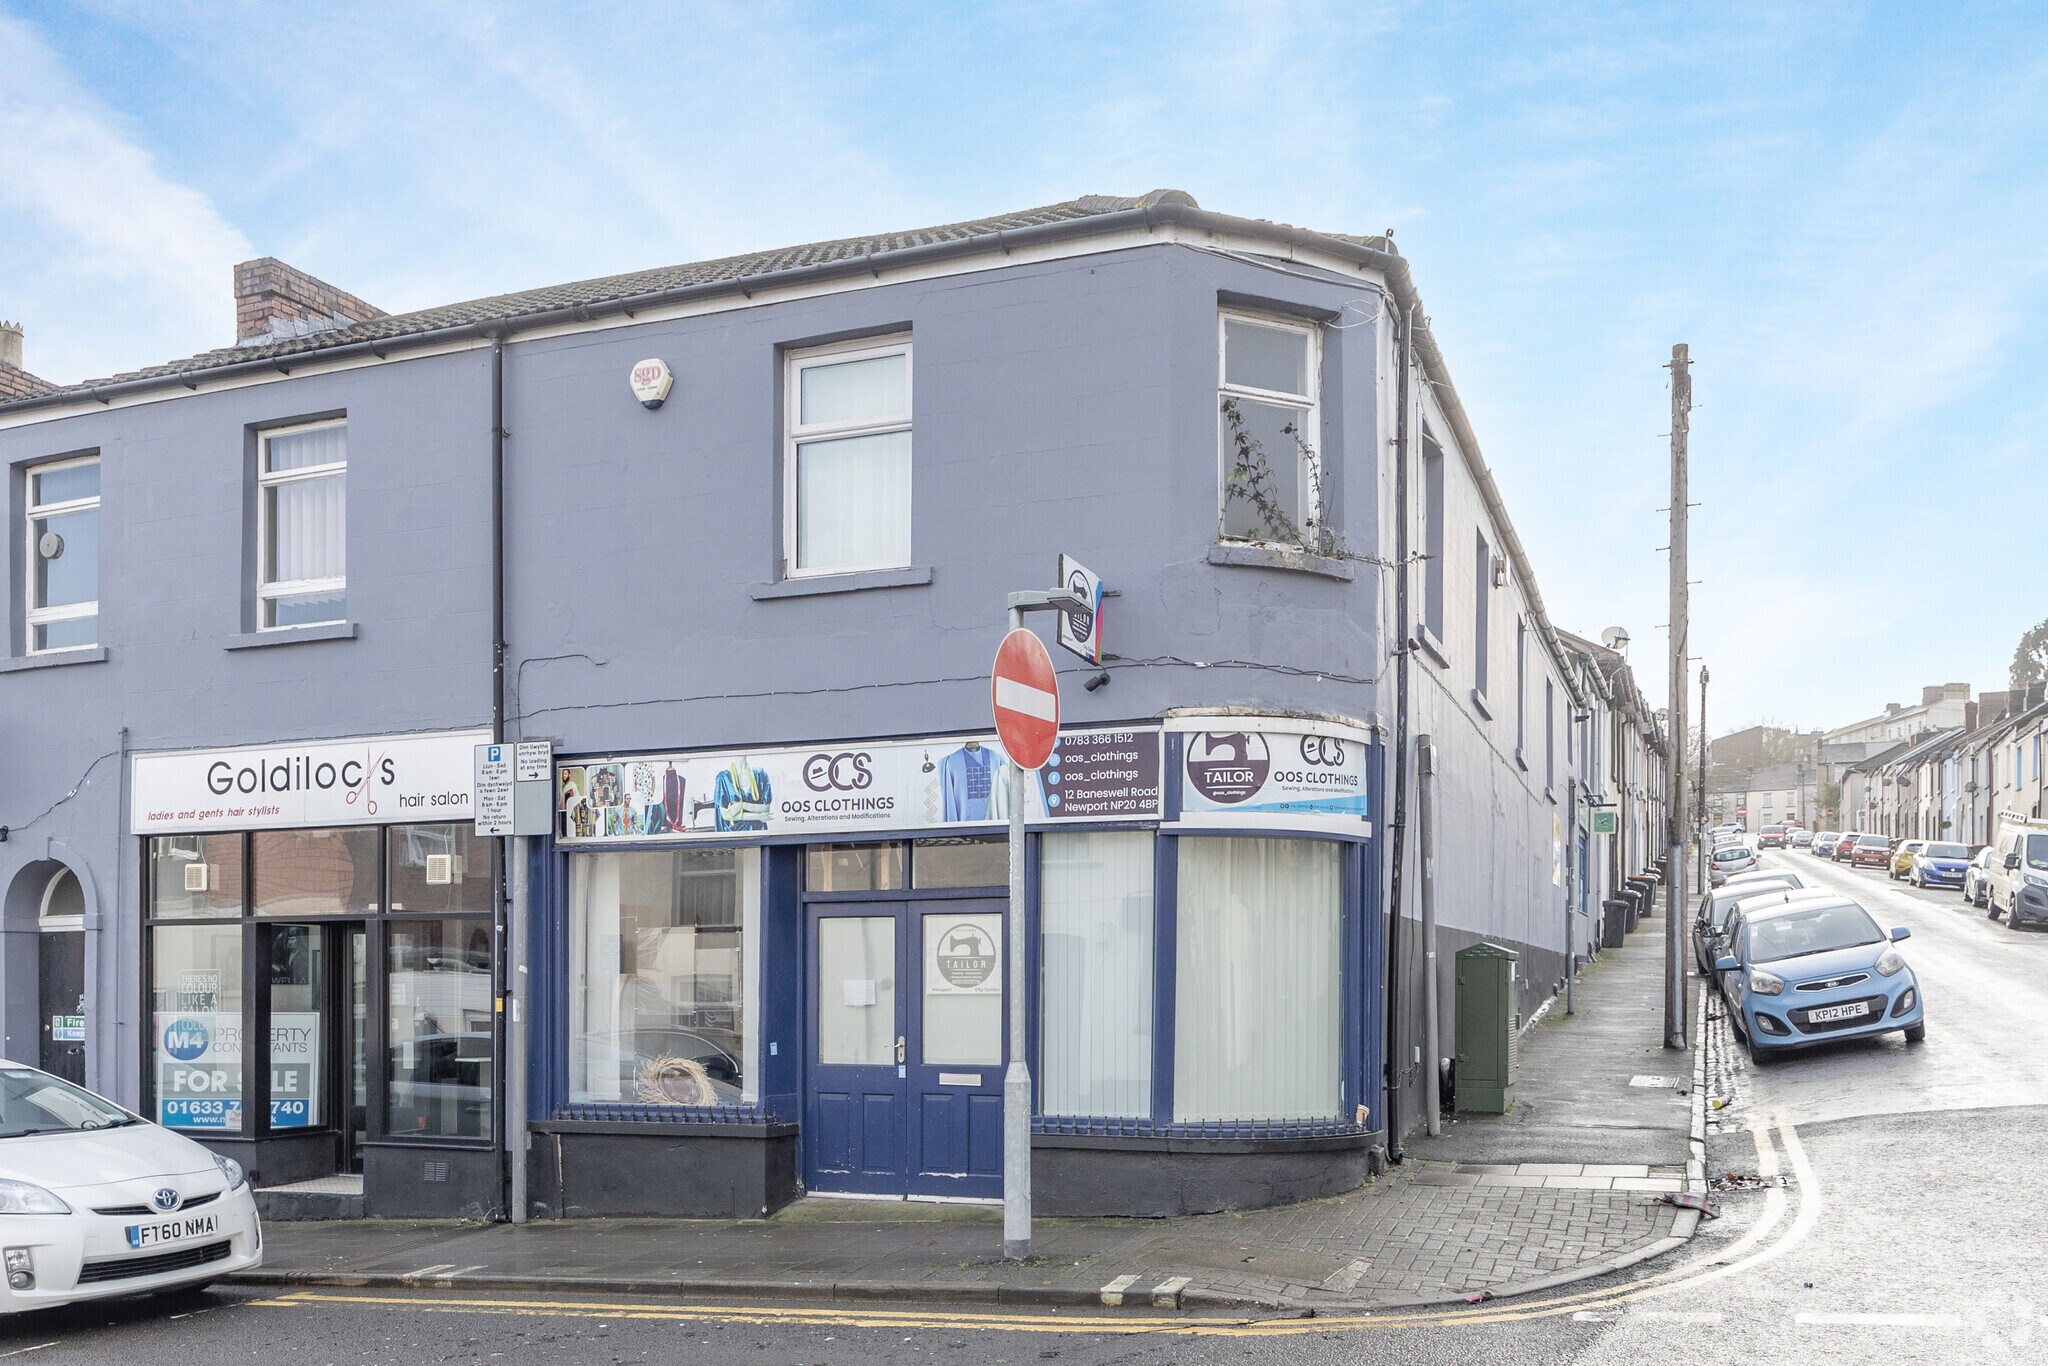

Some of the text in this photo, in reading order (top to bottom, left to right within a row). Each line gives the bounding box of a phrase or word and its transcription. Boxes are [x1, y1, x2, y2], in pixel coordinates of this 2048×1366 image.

[1065, 733, 1133, 746] 0783 366 1512
[1065, 751, 1138, 764] oos_clothings
[1065, 769, 1138, 781] oos_clothings
[1204, 771, 1254, 783] TAILOR
[1274, 771, 1358, 786] OOS CLOTHINGS
[399, 791, 469, 808] hair salon
[1065, 790, 1074, 800] 12
[1077, 787, 1128, 799] Baneswell
[781, 796, 895, 813] OOS CLOTHINGS
[1065, 799, 1159, 813] Newport NP20 4BP
[148, 805, 280, 821] ladies and gents hair stylists
[784, 815, 806, 823] Sewing,
[851, 812, 891, 820] Modifications
[947, 960, 986, 969] TAILOR
[208, 974, 218, 983] NO
[181, 983, 218, 994] COLOUR
[181, 993, 218, 1006] LIKE A
[1815, 1005, 1862, 1020] KP12 HPE
[67, 1018, 85, 1027] Fire
[168, 1031, 205, 1049] M4
[173, 1070, 227, 1092] FOR
[167, 1101, 223, 1115] 01633
[141, 1217, 214, 1244] FT60 NMA
